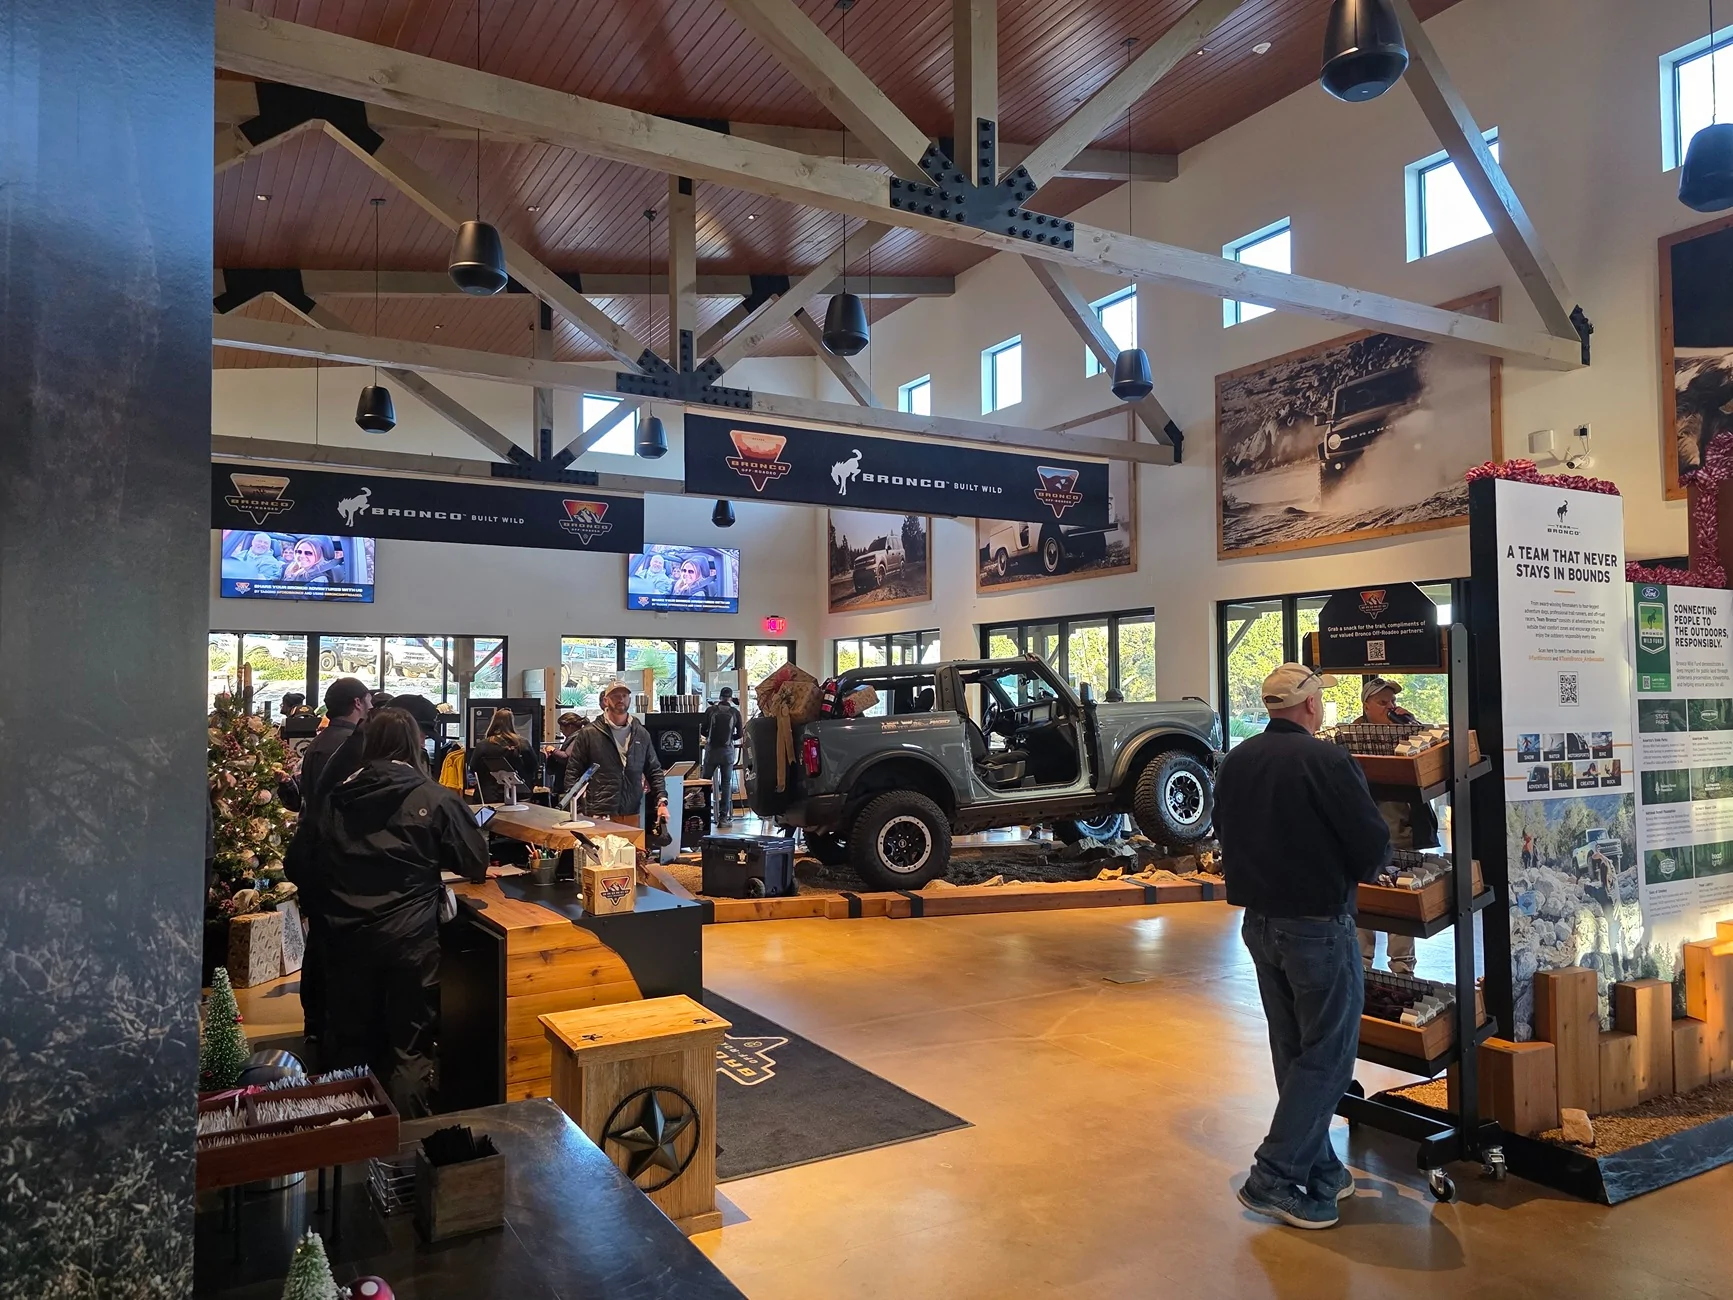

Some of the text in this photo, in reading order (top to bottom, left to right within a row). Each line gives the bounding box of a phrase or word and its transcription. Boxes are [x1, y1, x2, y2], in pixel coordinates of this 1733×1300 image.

[731, 460, 786, 471] BRONCO
[862, 473, 1003, 494] BRONCO BUILT WILD
[1038, 492, 1079, 500] BRONCO
[231, 499, 289, 508] BRONCO
[371, 507, 525, 525] BRONCO BUILT WILD
[563, 522, 608, 530] BRONCO
[1547, 528, 1580, 536] BRONCO
[1507, 545, 1617, 567] A TEAM THAT NEVER
[1516, 564, 1610, 583] STAYS IN BOUNDS
[1673, 604, 1717, 616] CONNECTING
[1387, 621, 1419, 629] compliments
[1674, 615, 1711, 627] PEOPLE TO
[1372, 628, 1399, 636] Off-Roadeo
[1400, 628, 1424, 636] partners:
[1674, 626, 1729, 639] THE OUTDOORS,
[1675, 637, 1723, 648] RESPONSIBLY.
